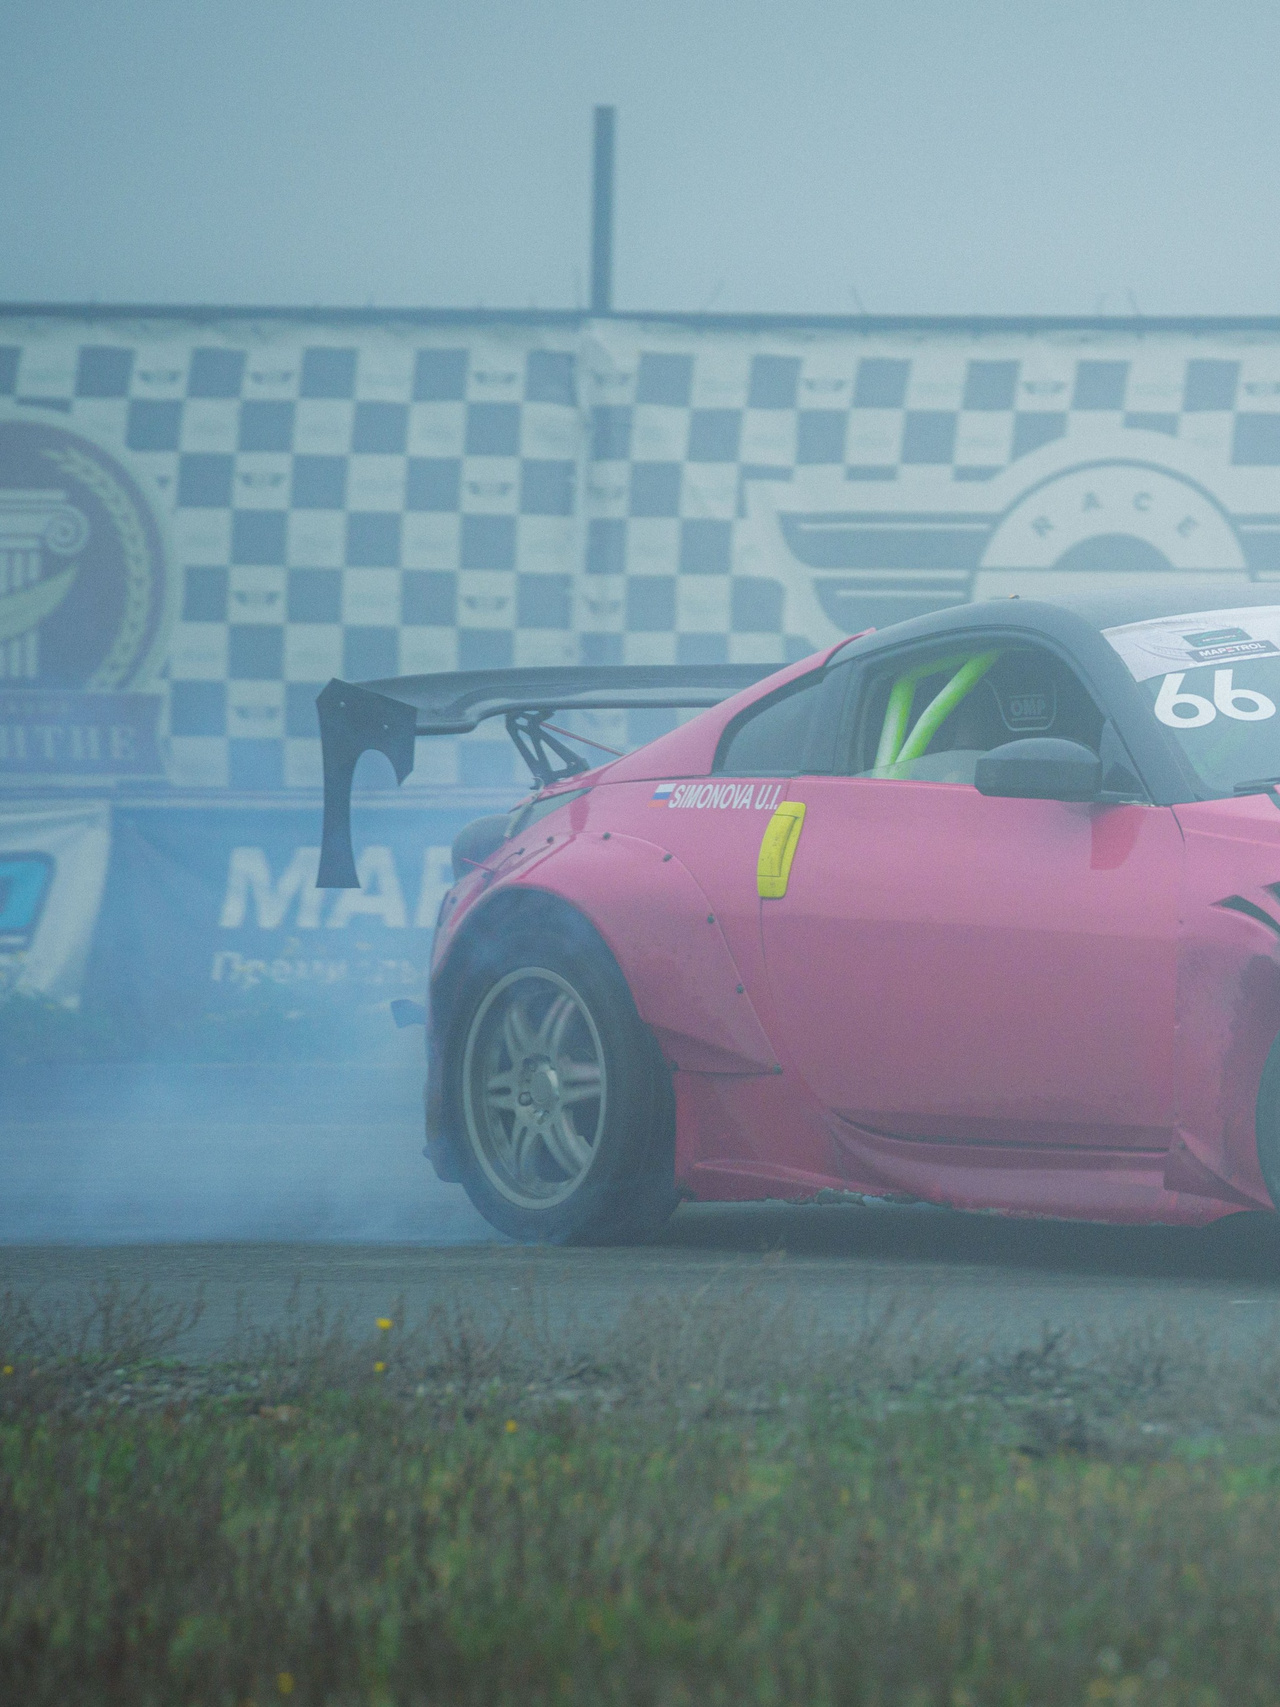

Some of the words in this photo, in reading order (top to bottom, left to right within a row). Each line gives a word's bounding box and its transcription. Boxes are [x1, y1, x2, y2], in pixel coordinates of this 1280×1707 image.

[1029, 490, 1200, 540] RACE
[1009, 698, 1047, 717] OMP
[1153, 669, 1277, 729] 66
[668, 783, 755, 809] SIMONOVA
